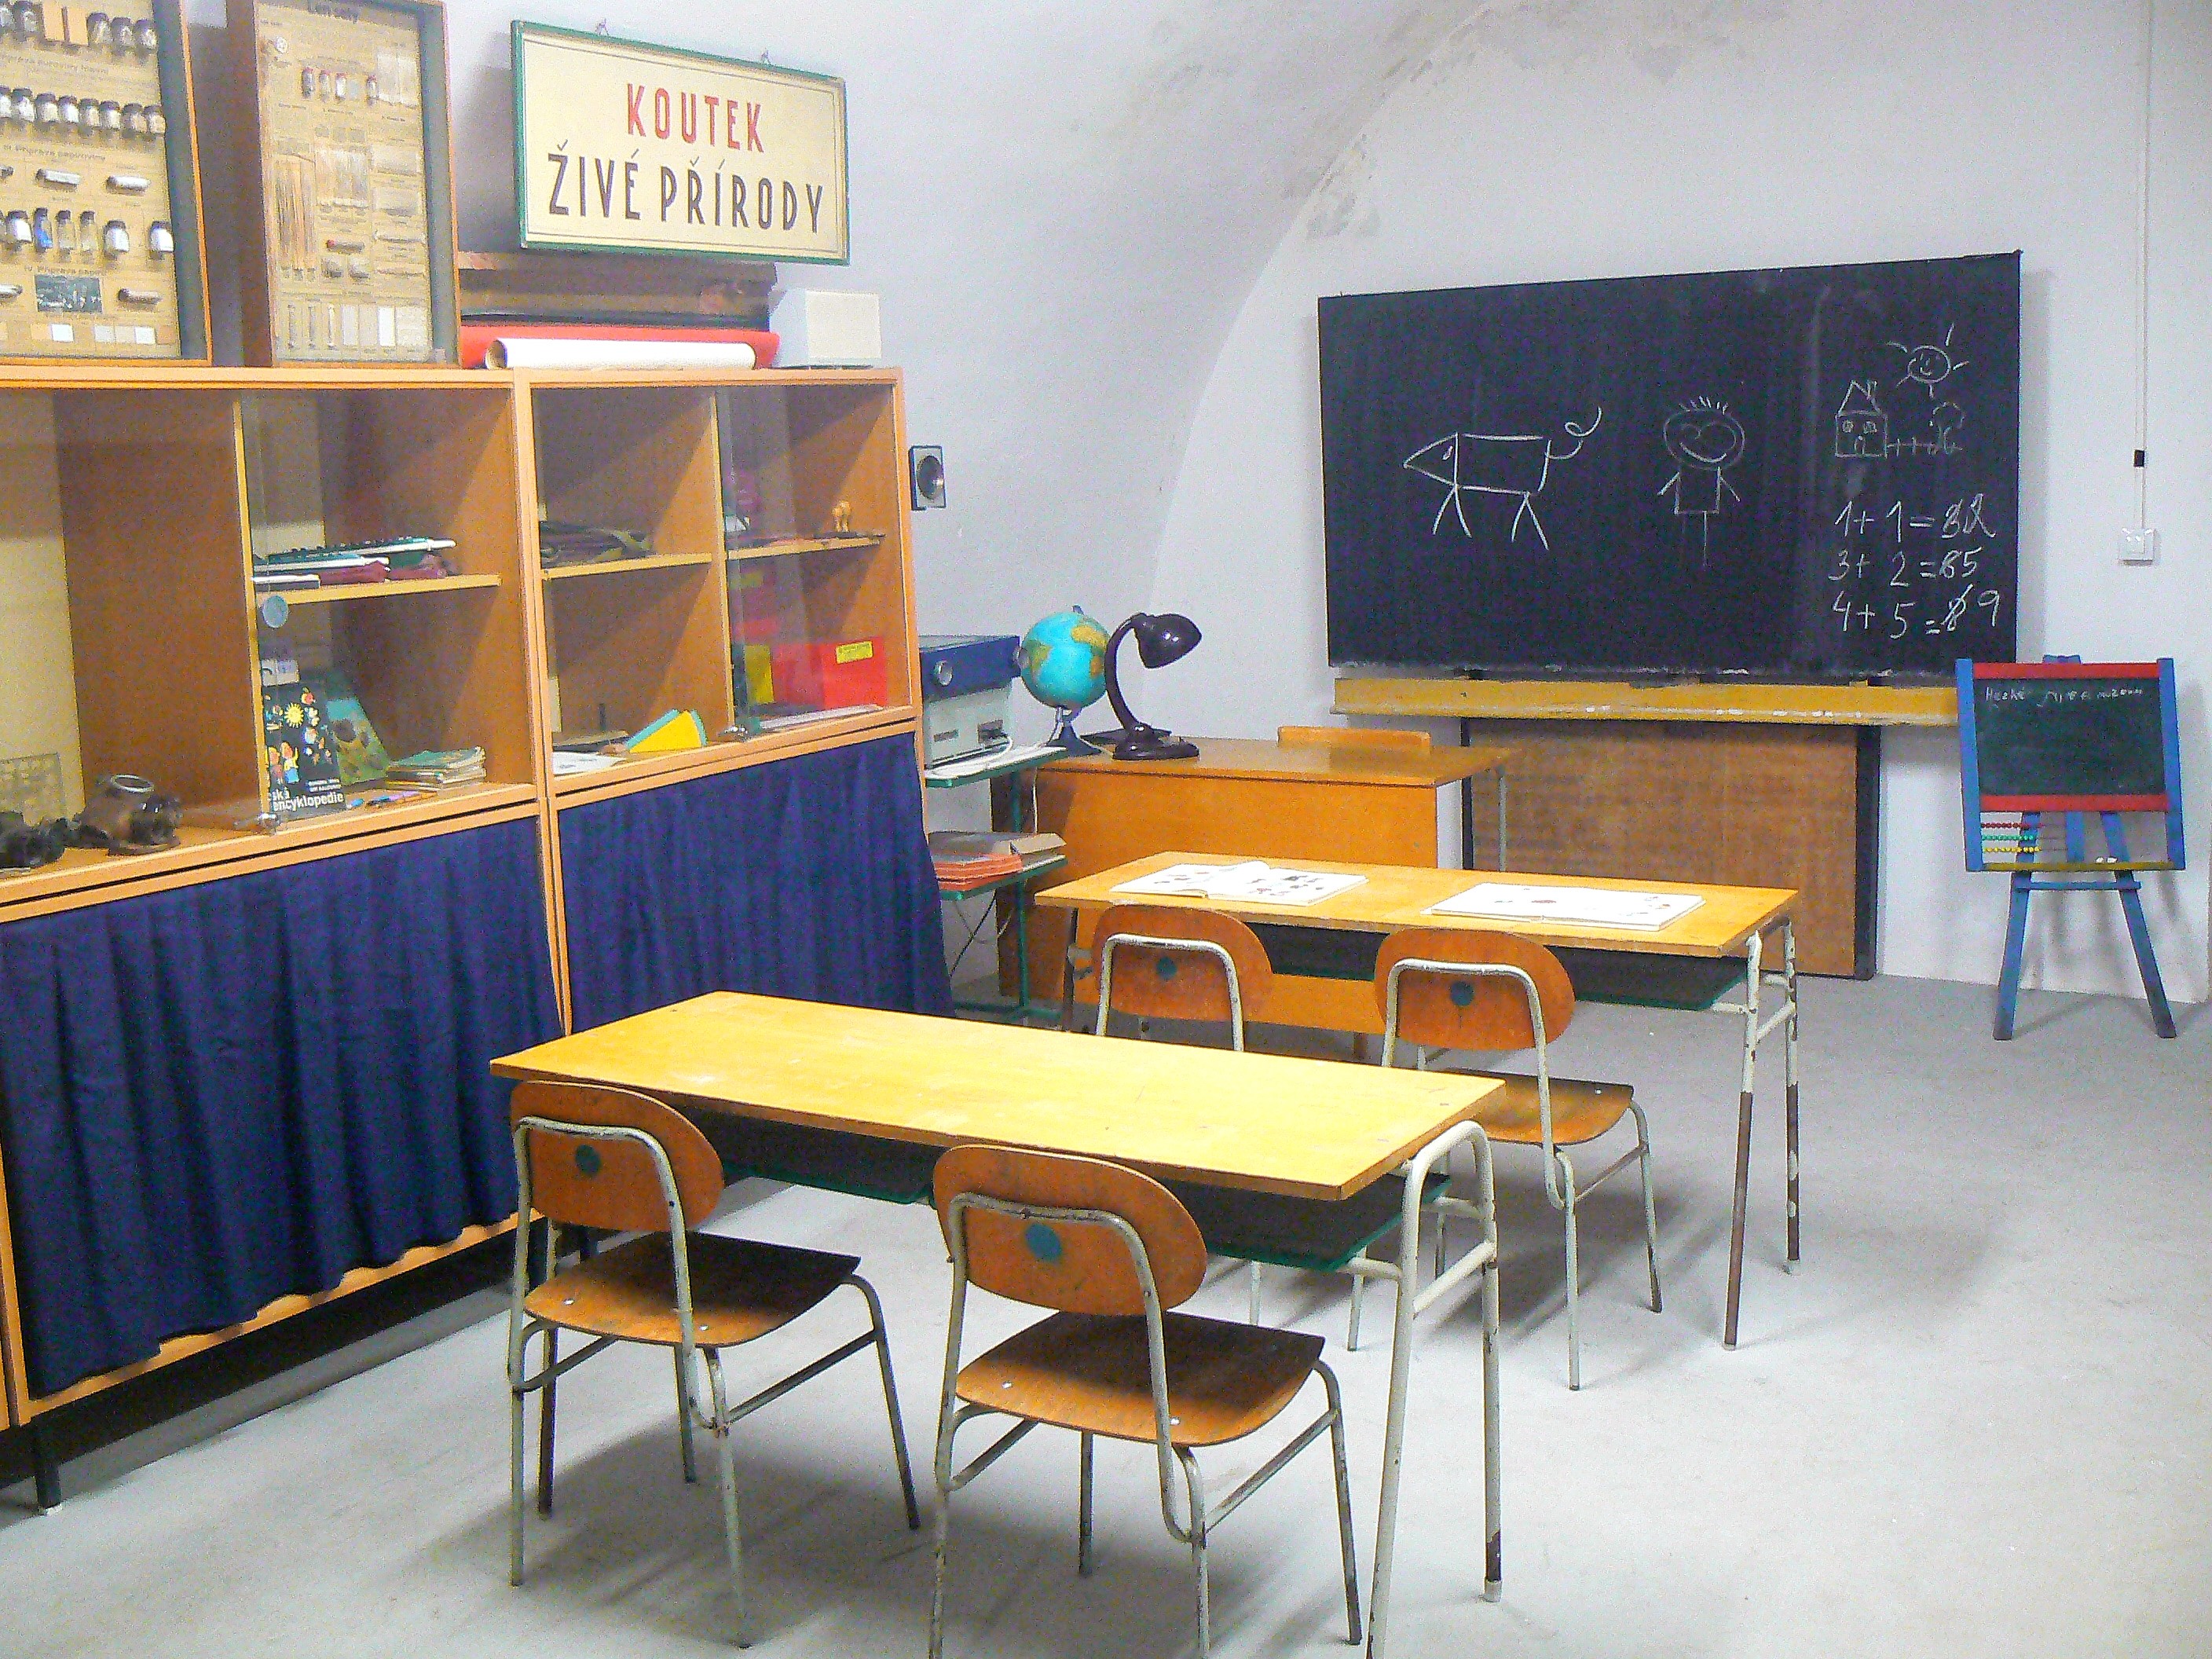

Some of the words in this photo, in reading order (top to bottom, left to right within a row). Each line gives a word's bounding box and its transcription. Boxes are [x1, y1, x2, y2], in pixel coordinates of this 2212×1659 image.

[627, 82, 764, 153] KOUTEK
[548, 139, 641, 221] ŽIVÉ
[661, 156, 823, 235] PŘÍRODY
[272, 791, 345, 812] encyklopedie
